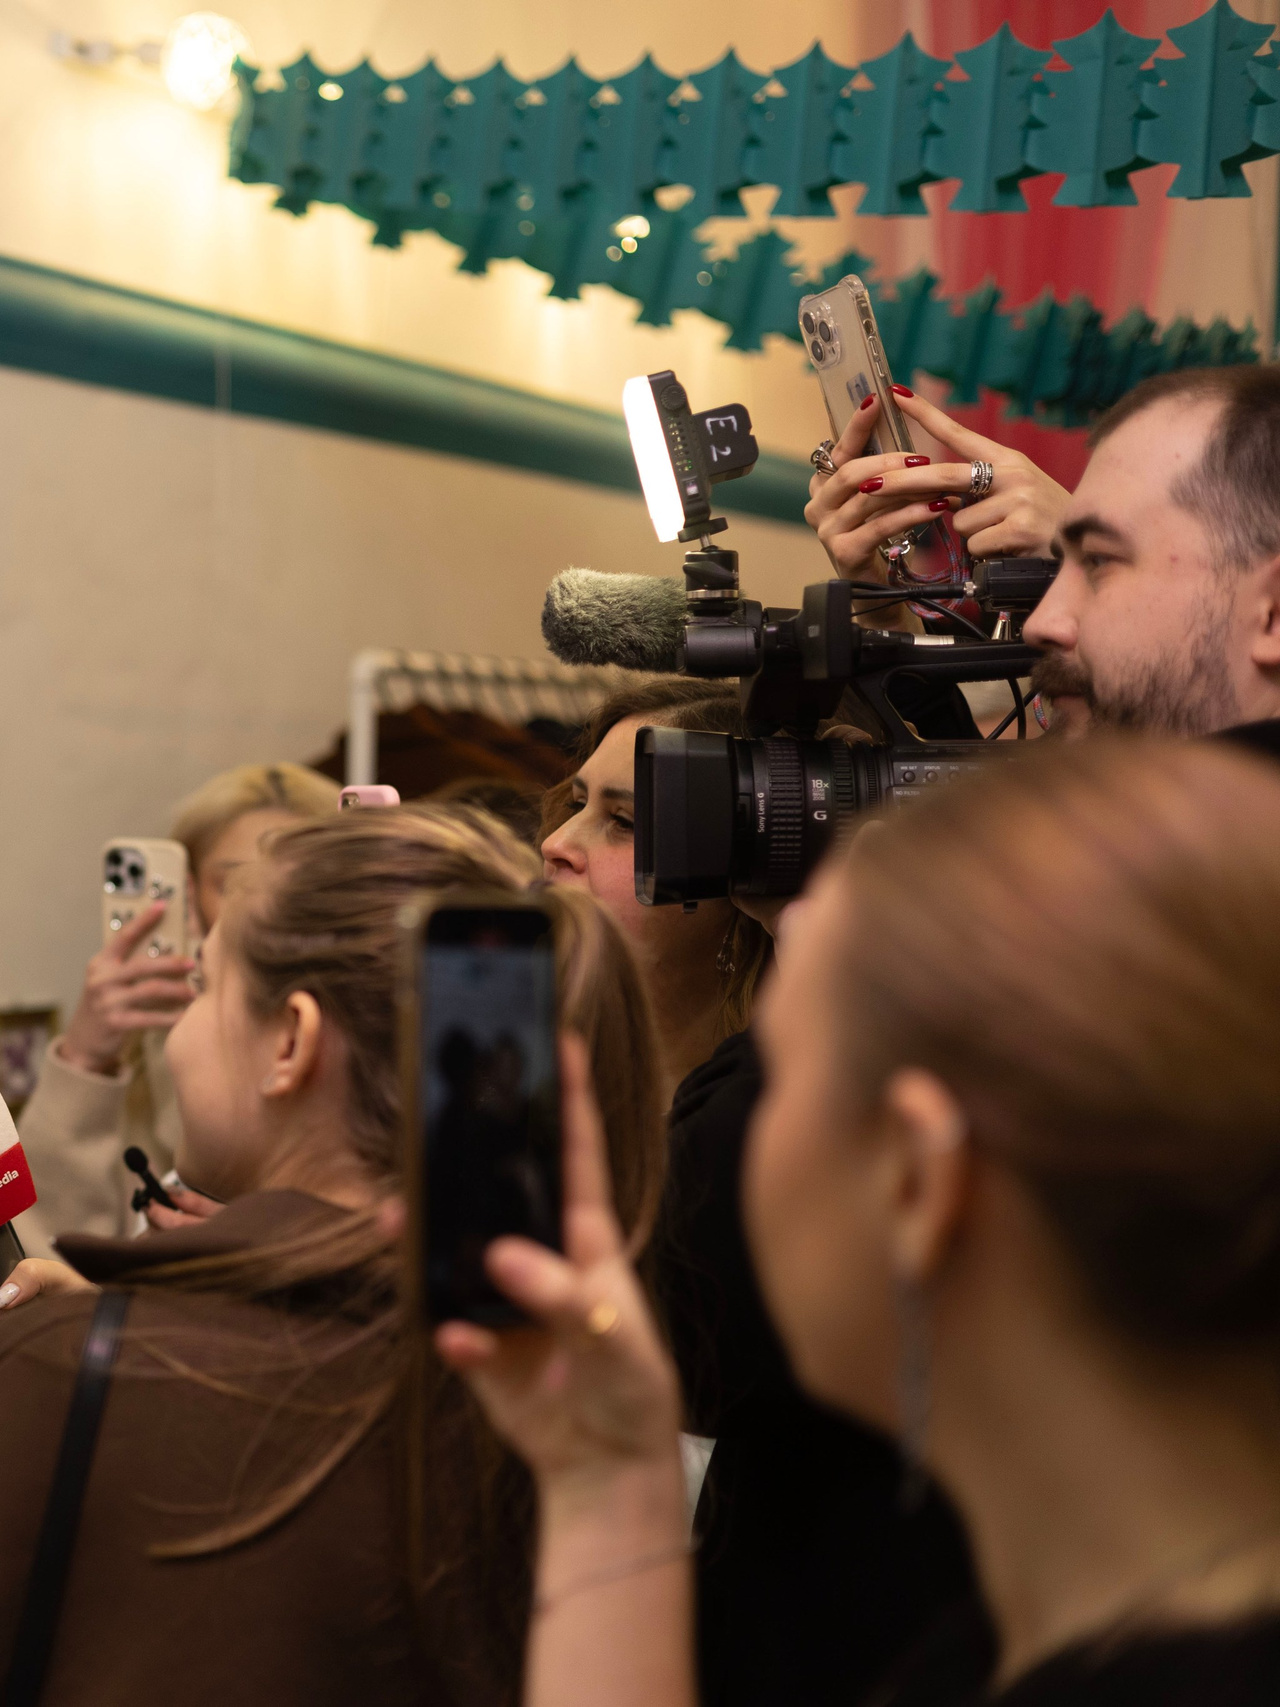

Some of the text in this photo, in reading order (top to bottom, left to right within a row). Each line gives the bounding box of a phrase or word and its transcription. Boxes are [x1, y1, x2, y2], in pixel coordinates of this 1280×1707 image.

[811, 779, 830, 789] 18x
[757, 799, 765, 815] Lens
[813, 810, 828, 821] G
[757, 816, 766, 833] Sony
